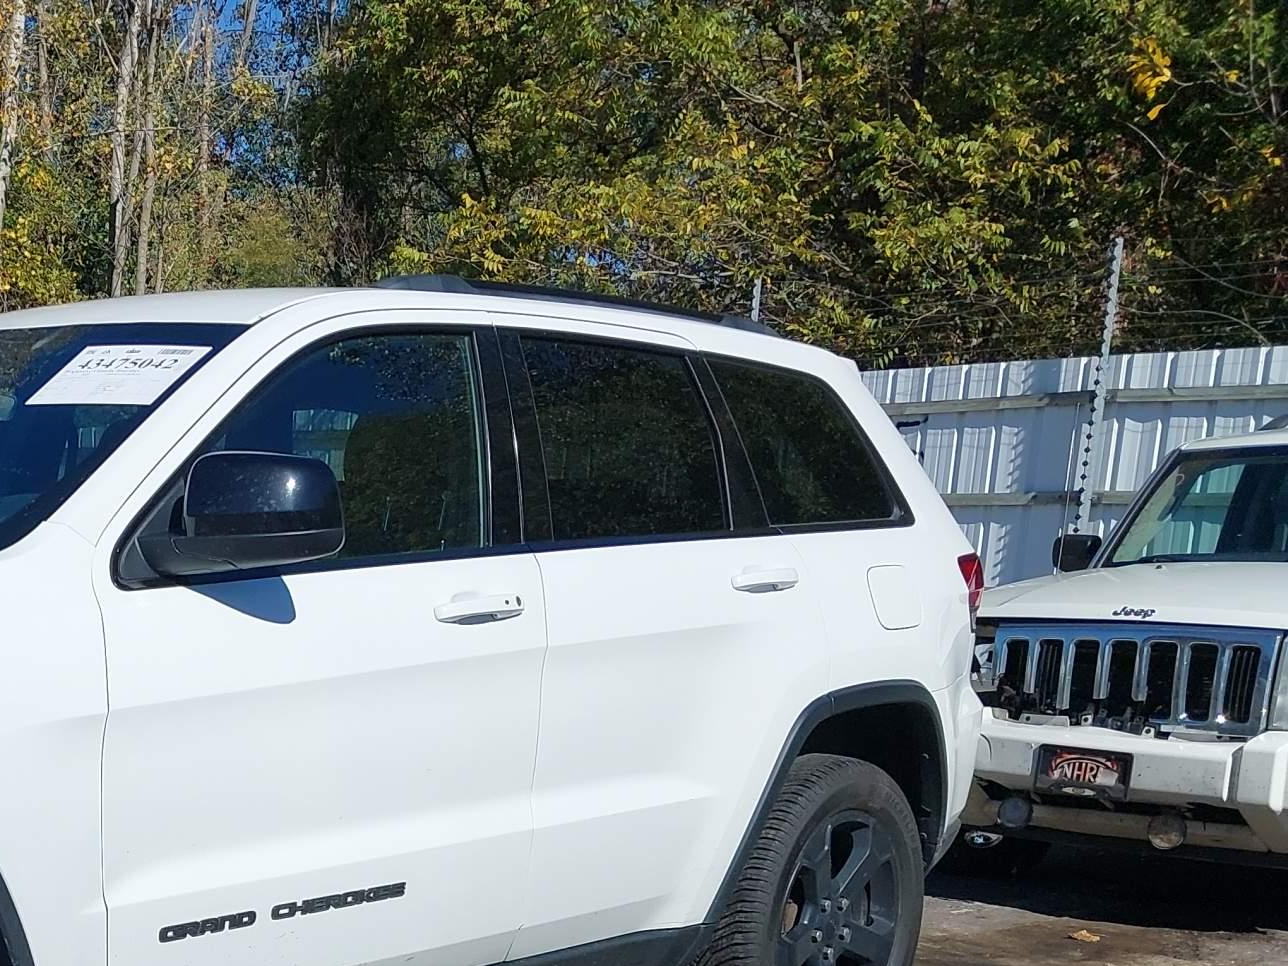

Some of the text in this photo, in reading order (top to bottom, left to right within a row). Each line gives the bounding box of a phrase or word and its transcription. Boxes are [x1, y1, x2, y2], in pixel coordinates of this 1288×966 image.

[78, 358, 179, 369] 43475042
[1112, 606, 1156, 619] Jeep
[159, 882, 406, 943] GRAND CHEROKEE
